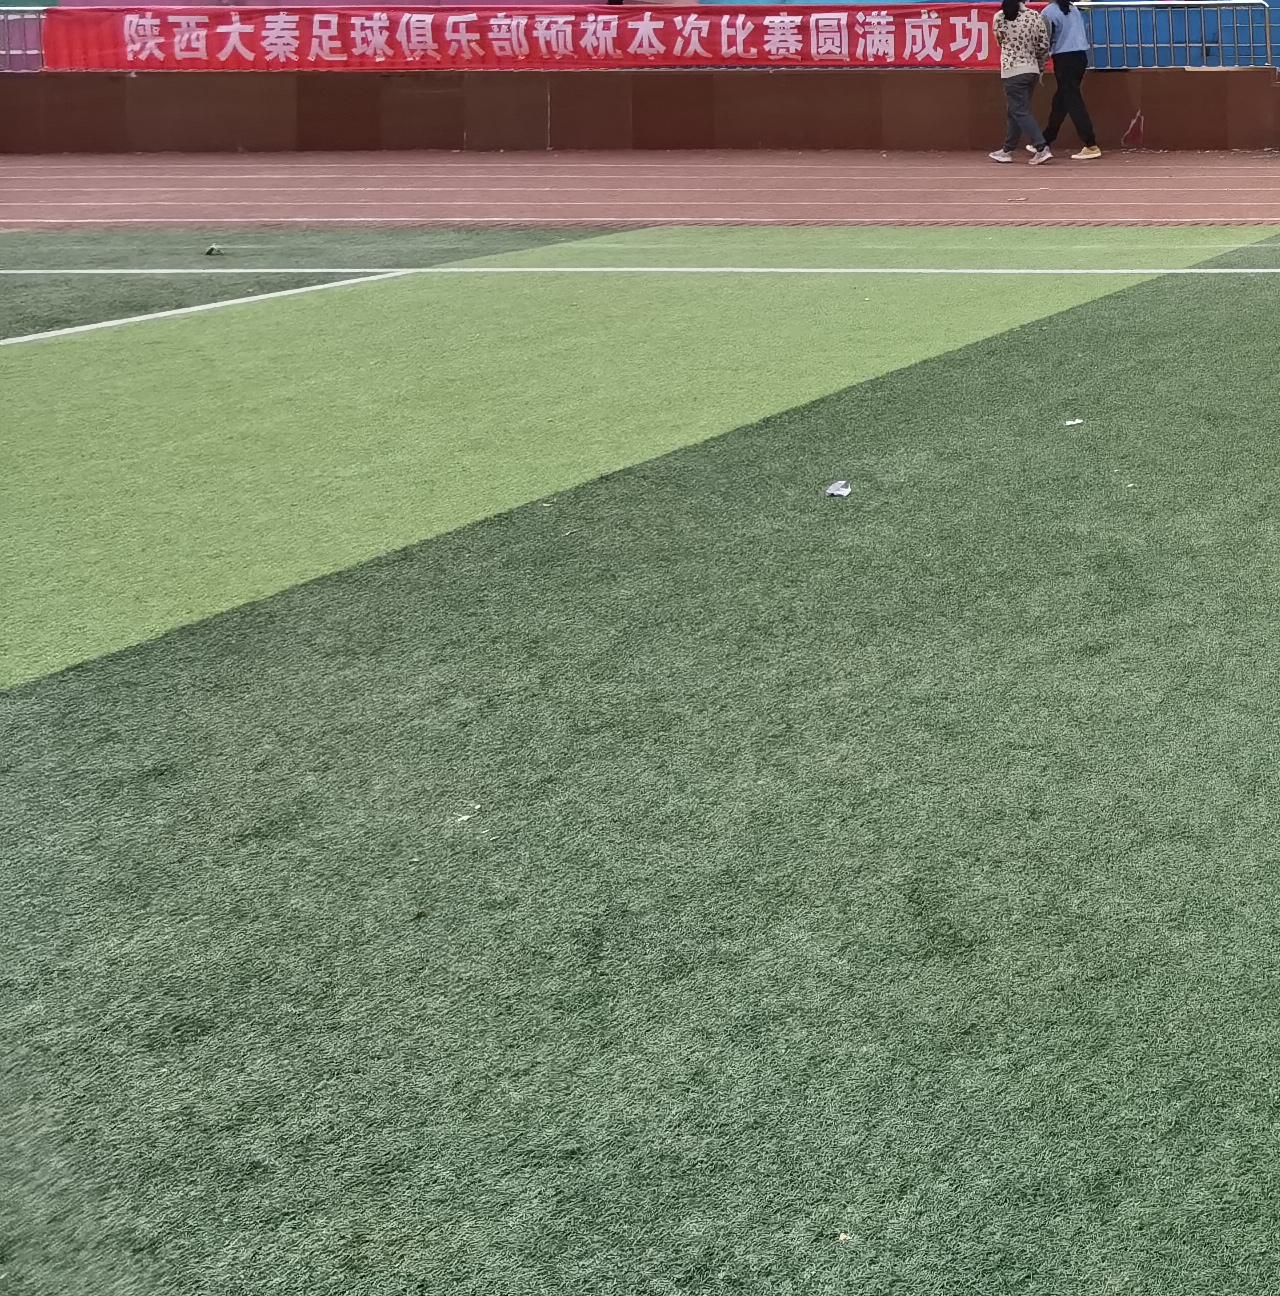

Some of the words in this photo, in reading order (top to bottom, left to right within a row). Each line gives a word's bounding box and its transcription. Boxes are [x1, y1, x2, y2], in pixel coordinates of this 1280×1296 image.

[123, 9, 989, 63] 陕西大秦足球俱乐部预祝本次比赛圆满成功
